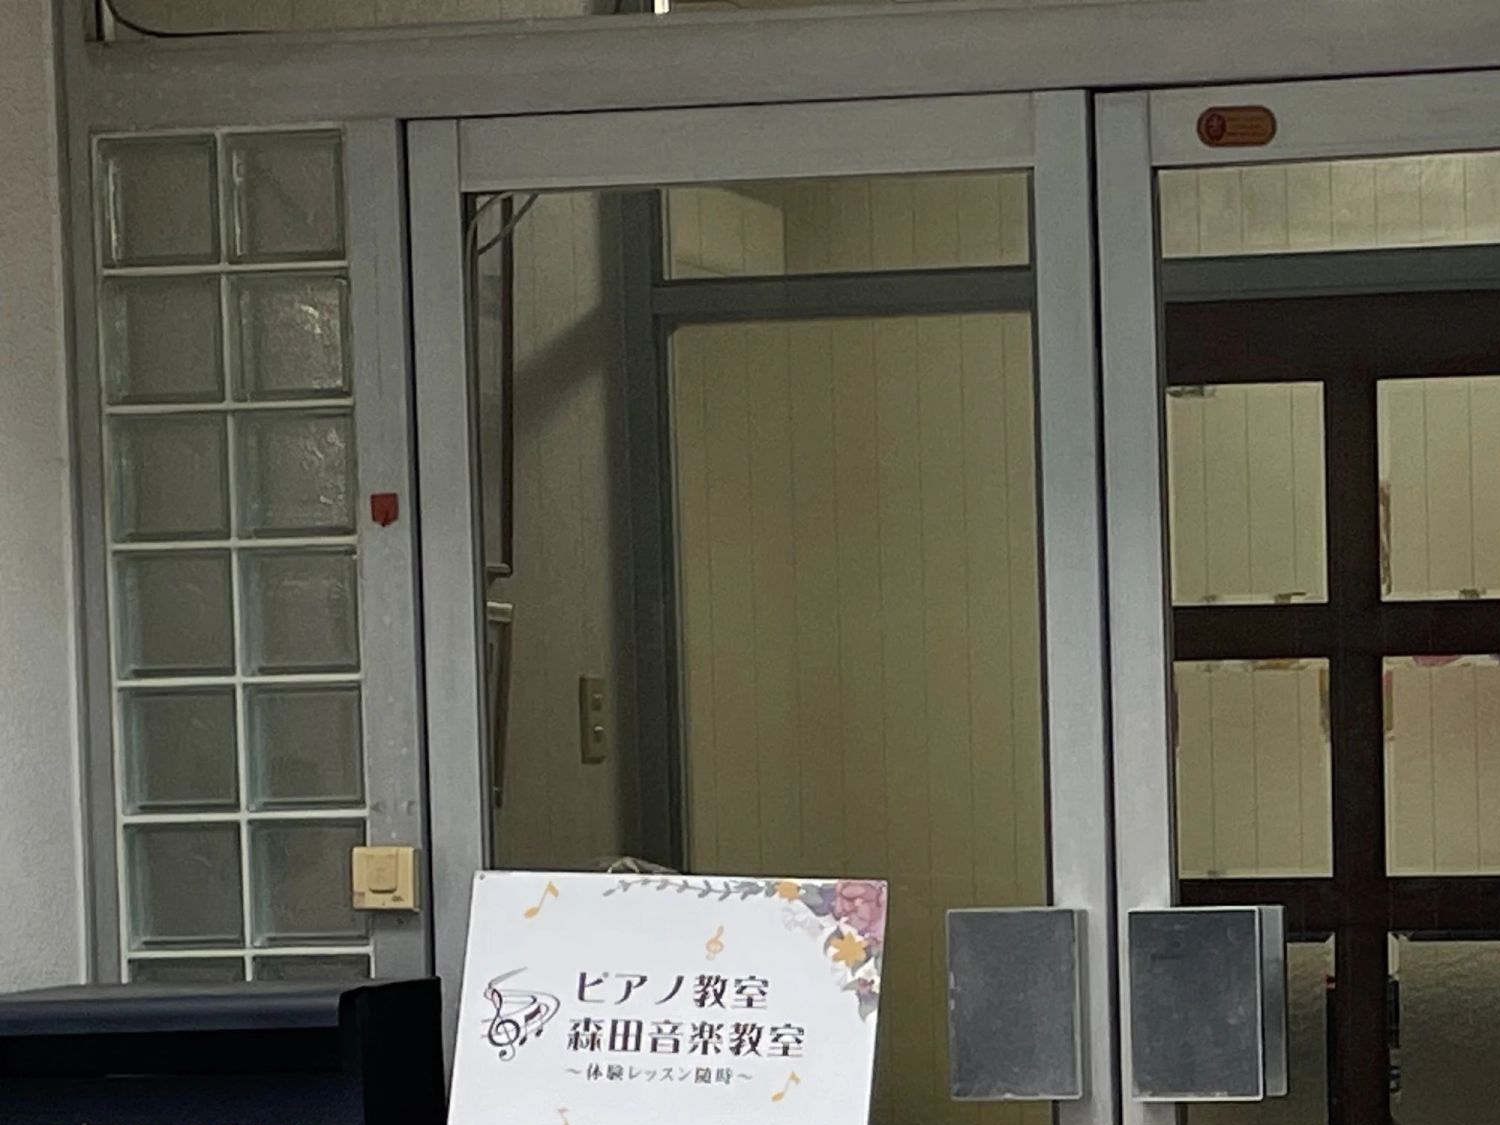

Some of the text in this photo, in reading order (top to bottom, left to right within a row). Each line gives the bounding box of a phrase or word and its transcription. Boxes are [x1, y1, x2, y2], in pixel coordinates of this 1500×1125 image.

[577, 971, 769, 1010] ピアノ教室
[566, 1017, 805, 1058] 森田音楽教室
